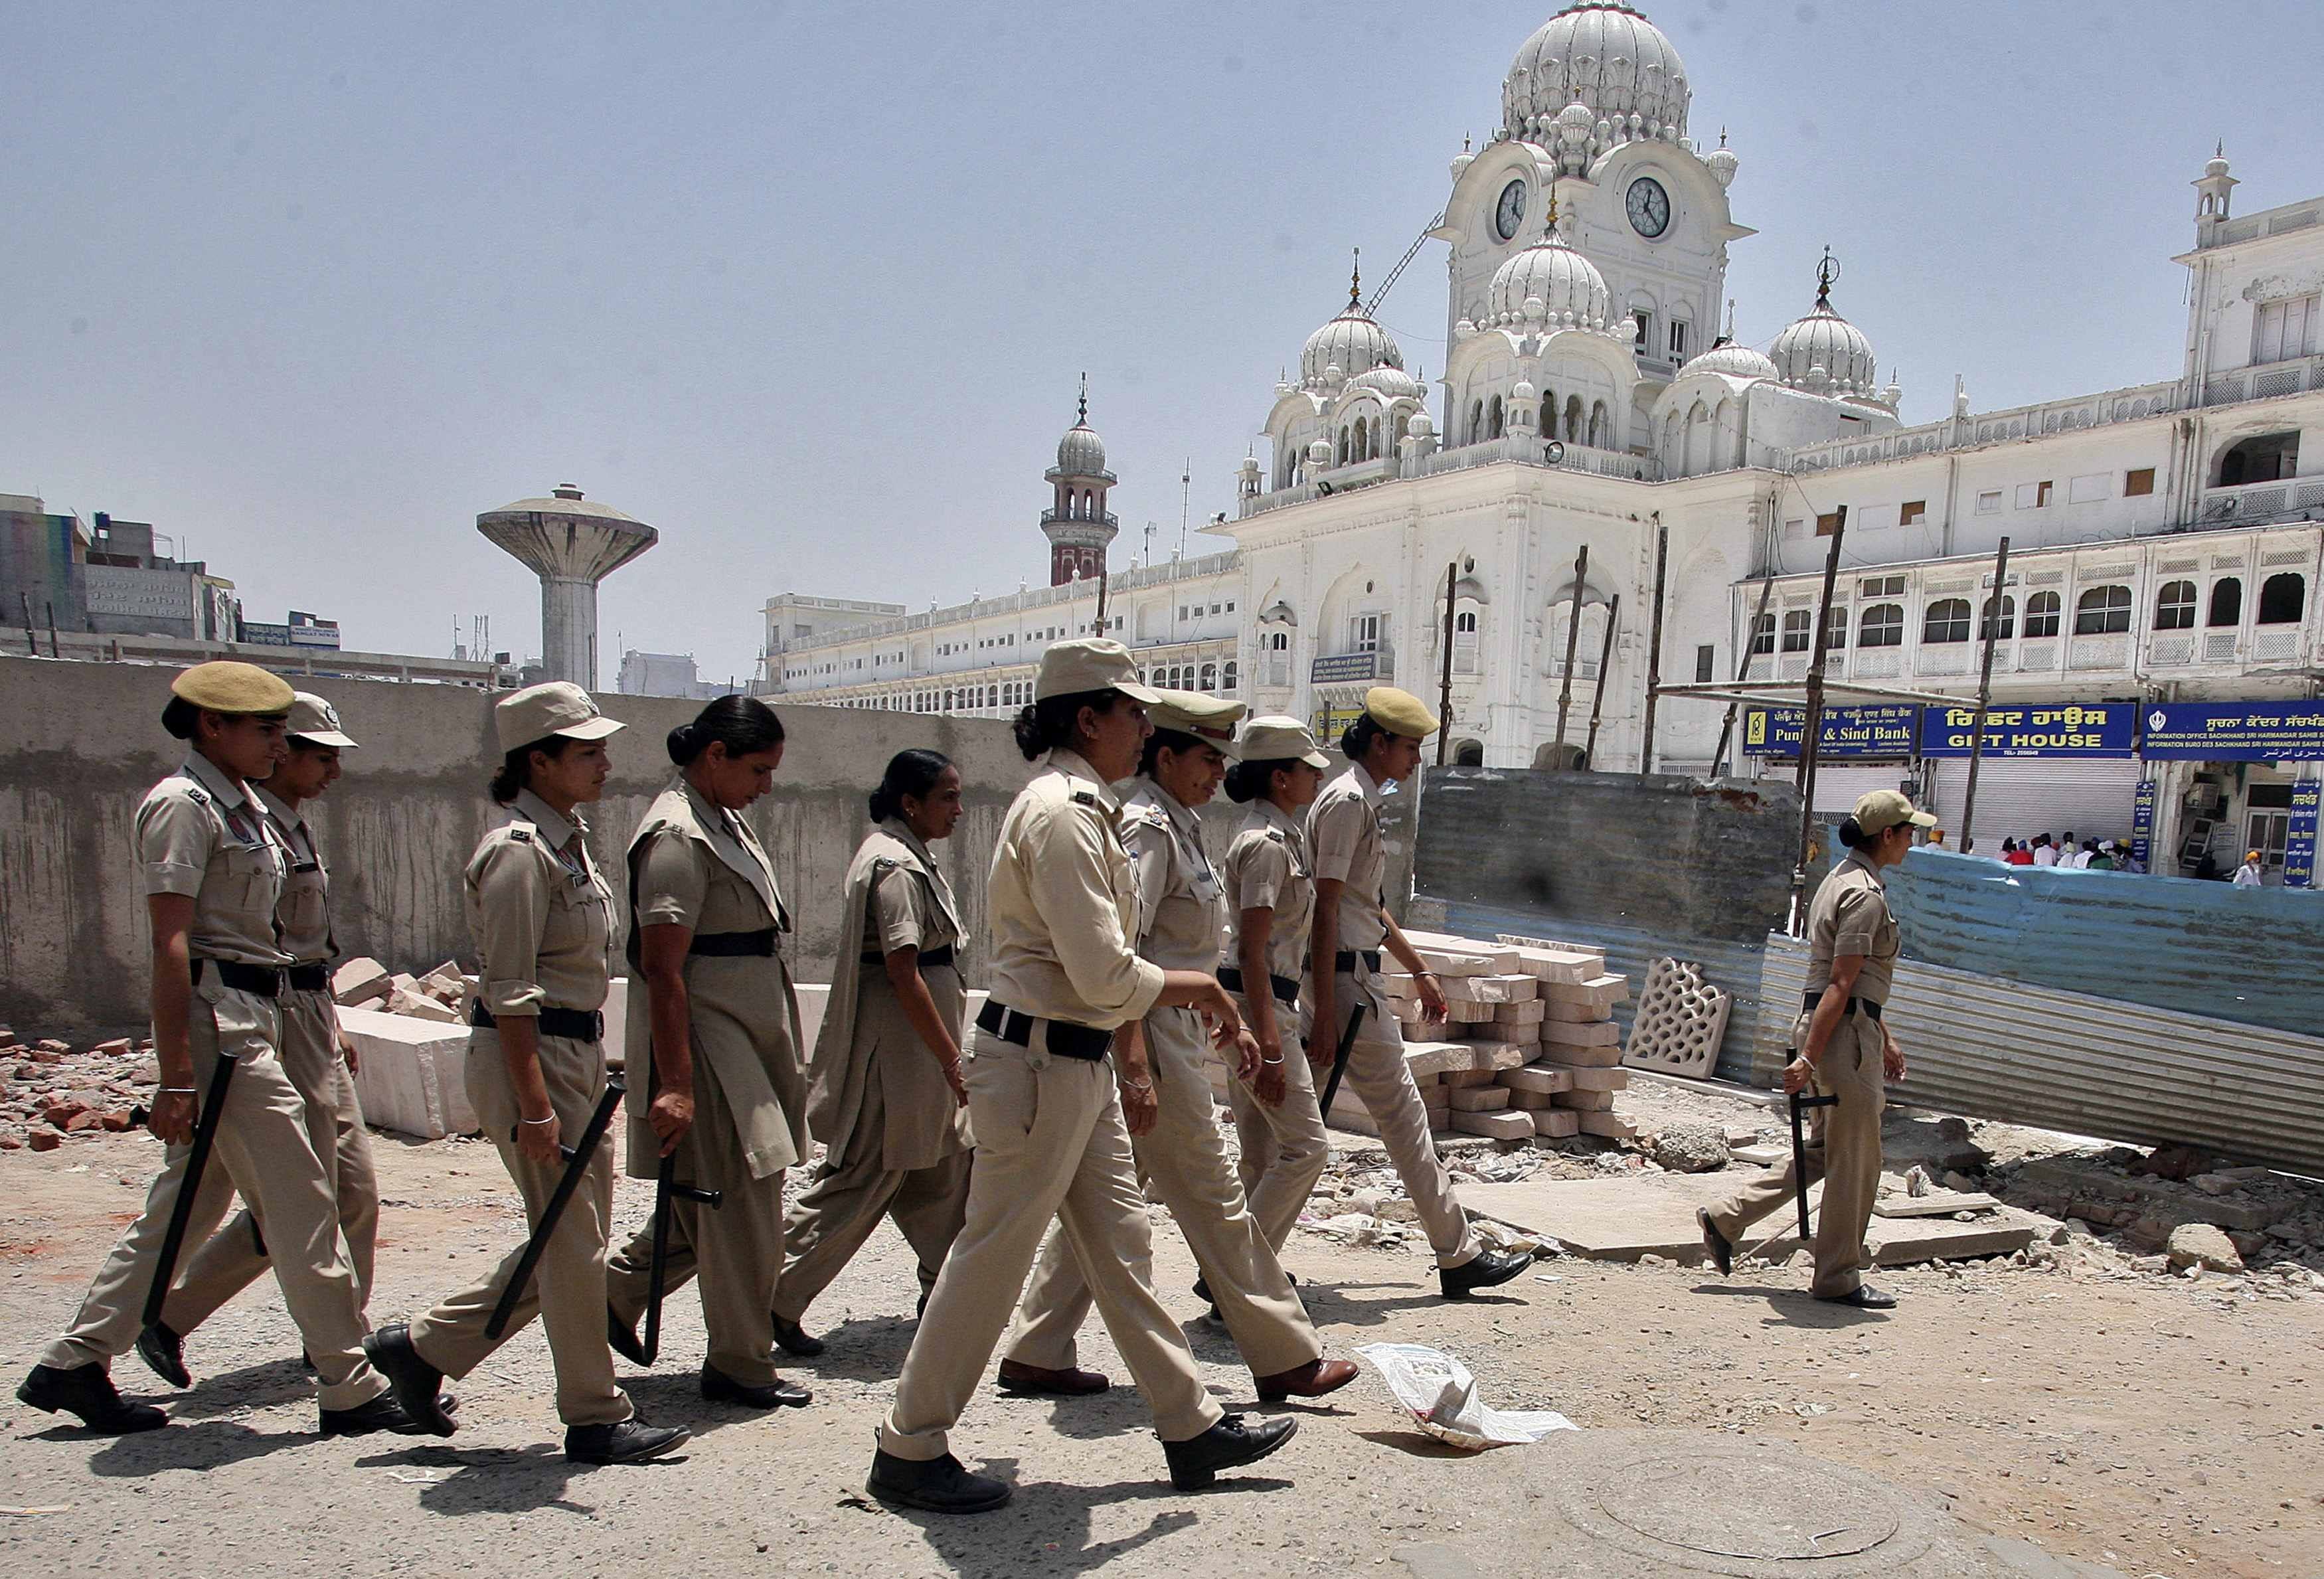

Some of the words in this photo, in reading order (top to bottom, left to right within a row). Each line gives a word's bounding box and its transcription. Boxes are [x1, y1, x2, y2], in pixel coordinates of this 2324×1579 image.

[1775, 728, 1804, 744] Punj
[1824, 727, 1836, 740] &
[1839, 726, 1870, 740] Sind
[1874, 725, 1910, 740] Bank
[2011, 734, 2102, 747] HOUSE
